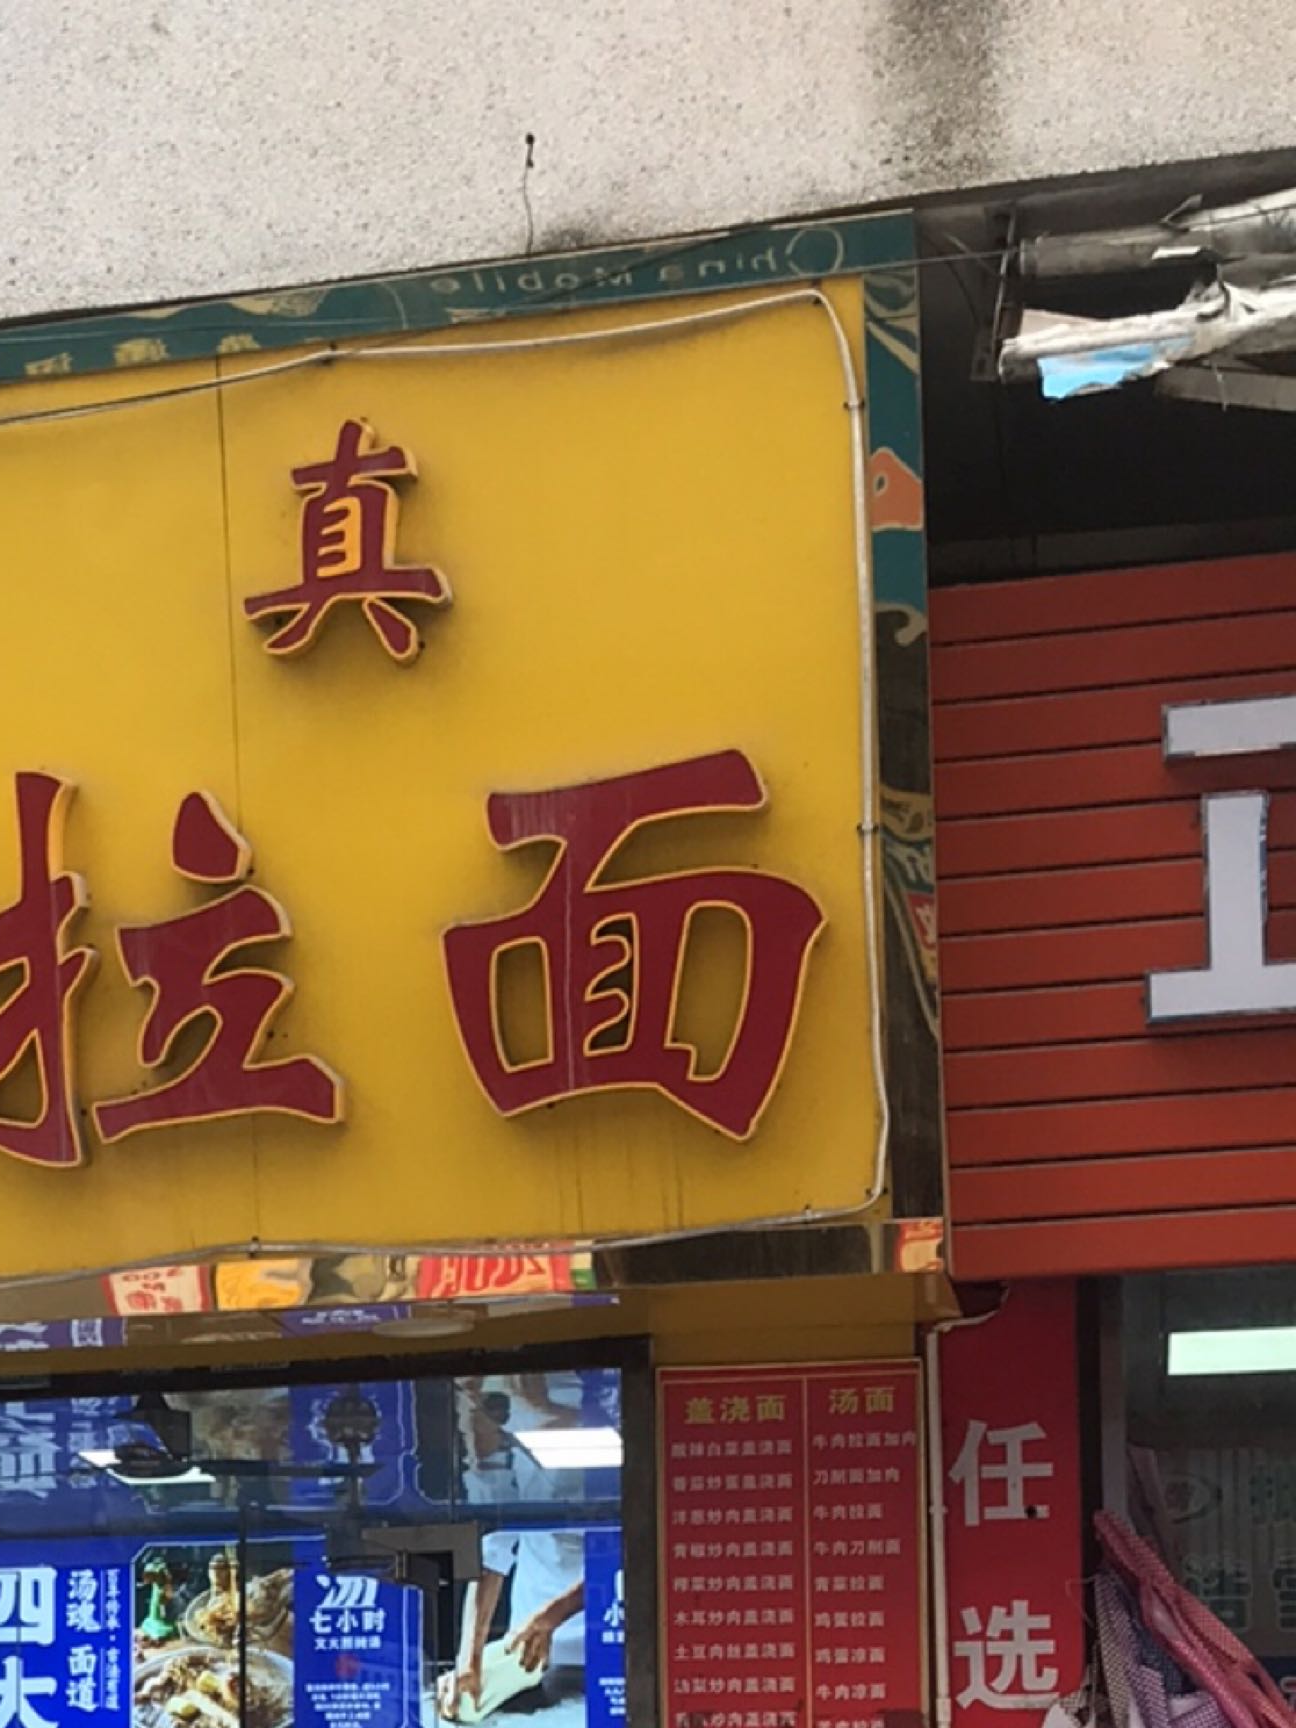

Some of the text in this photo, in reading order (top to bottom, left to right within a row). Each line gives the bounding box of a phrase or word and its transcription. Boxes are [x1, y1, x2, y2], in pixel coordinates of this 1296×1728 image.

[683, 1394, 786, 1424] 盖浇面
[828, 1386, 896, 1414] 汤面
[309, 1608, 386, 1633] 七小时
